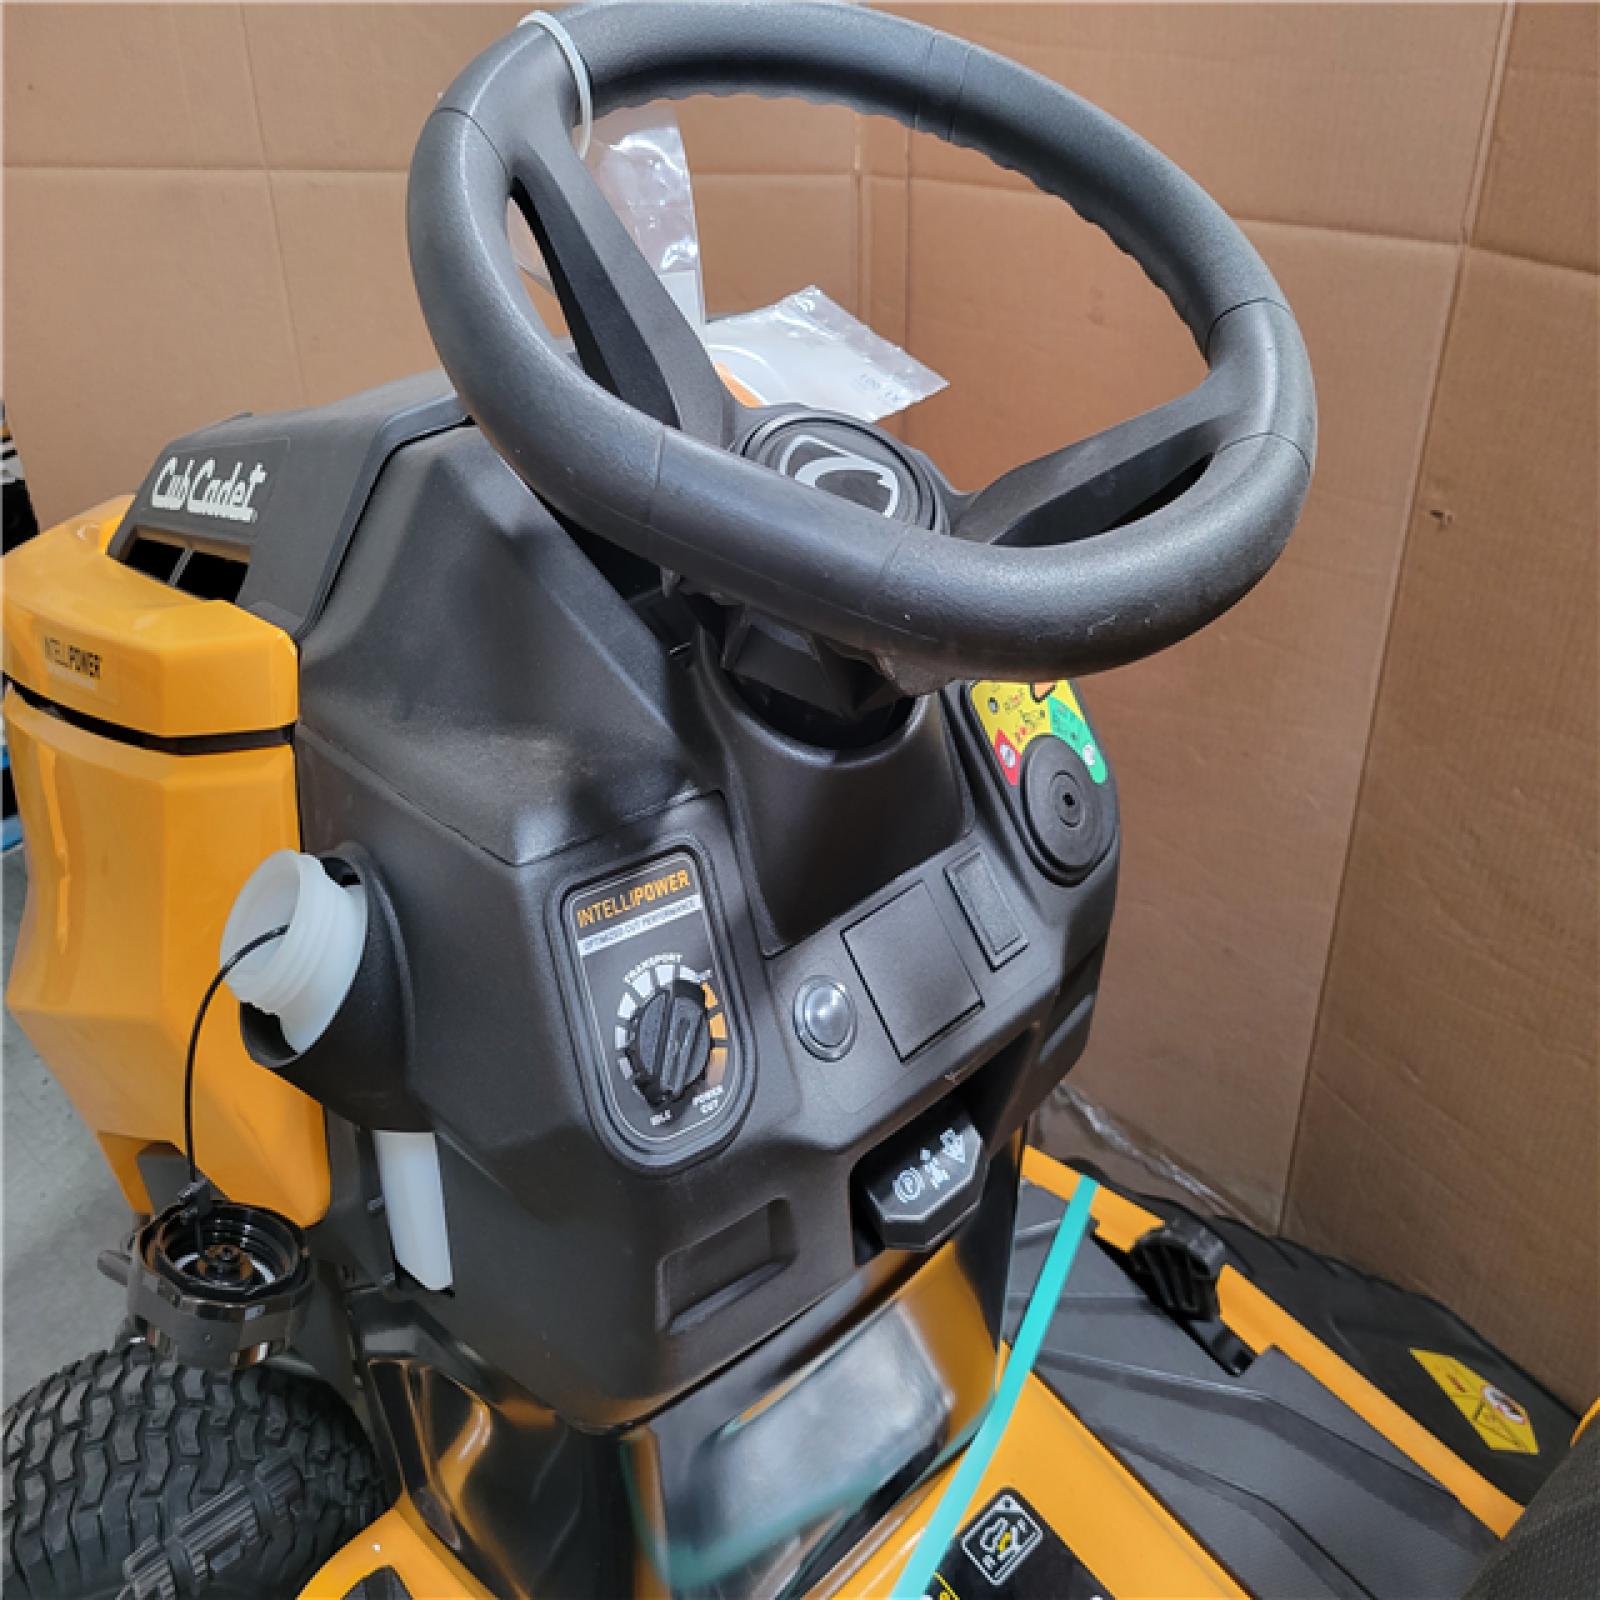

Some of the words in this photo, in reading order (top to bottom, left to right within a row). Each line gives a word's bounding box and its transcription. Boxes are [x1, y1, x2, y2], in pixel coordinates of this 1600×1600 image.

[151, 457, 195, 510] Cub
[187, 458, 266, 521] Cadet
[577, 869, 690, 928] INTELLIPOWER
